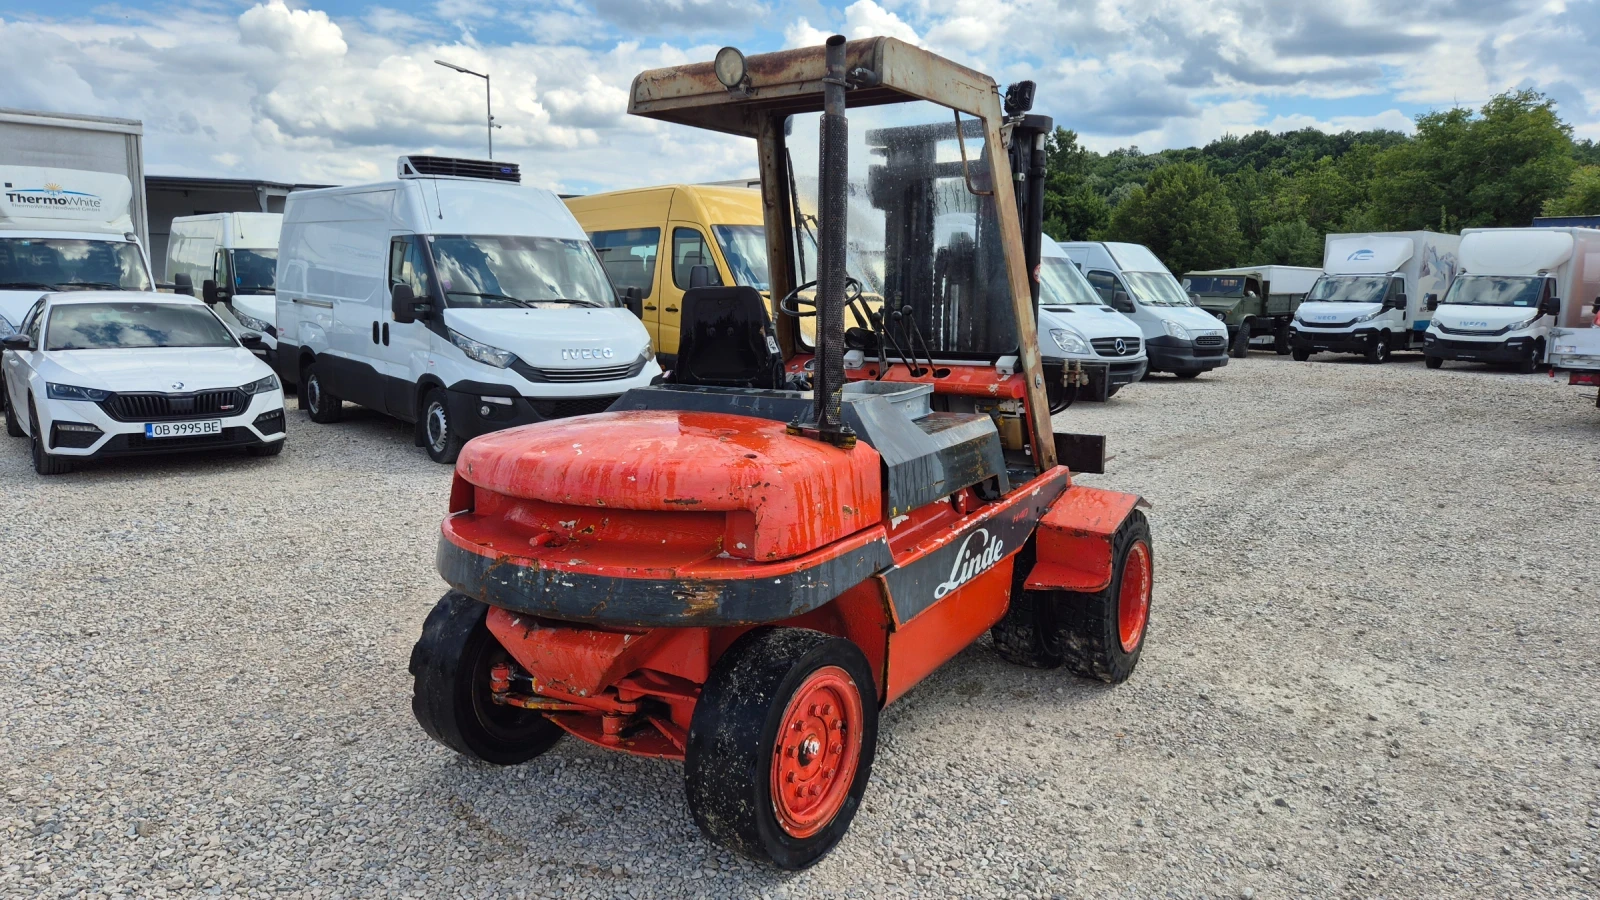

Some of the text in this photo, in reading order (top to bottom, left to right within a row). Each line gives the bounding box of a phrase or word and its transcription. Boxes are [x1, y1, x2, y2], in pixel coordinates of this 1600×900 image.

[5, 192, 101, 208] ThermoWhite
[561, 348, 614, 360] IVECO
[154, 421, 220, 435] OB 9995 BE
[934, 528, 1004, 599] Linde
